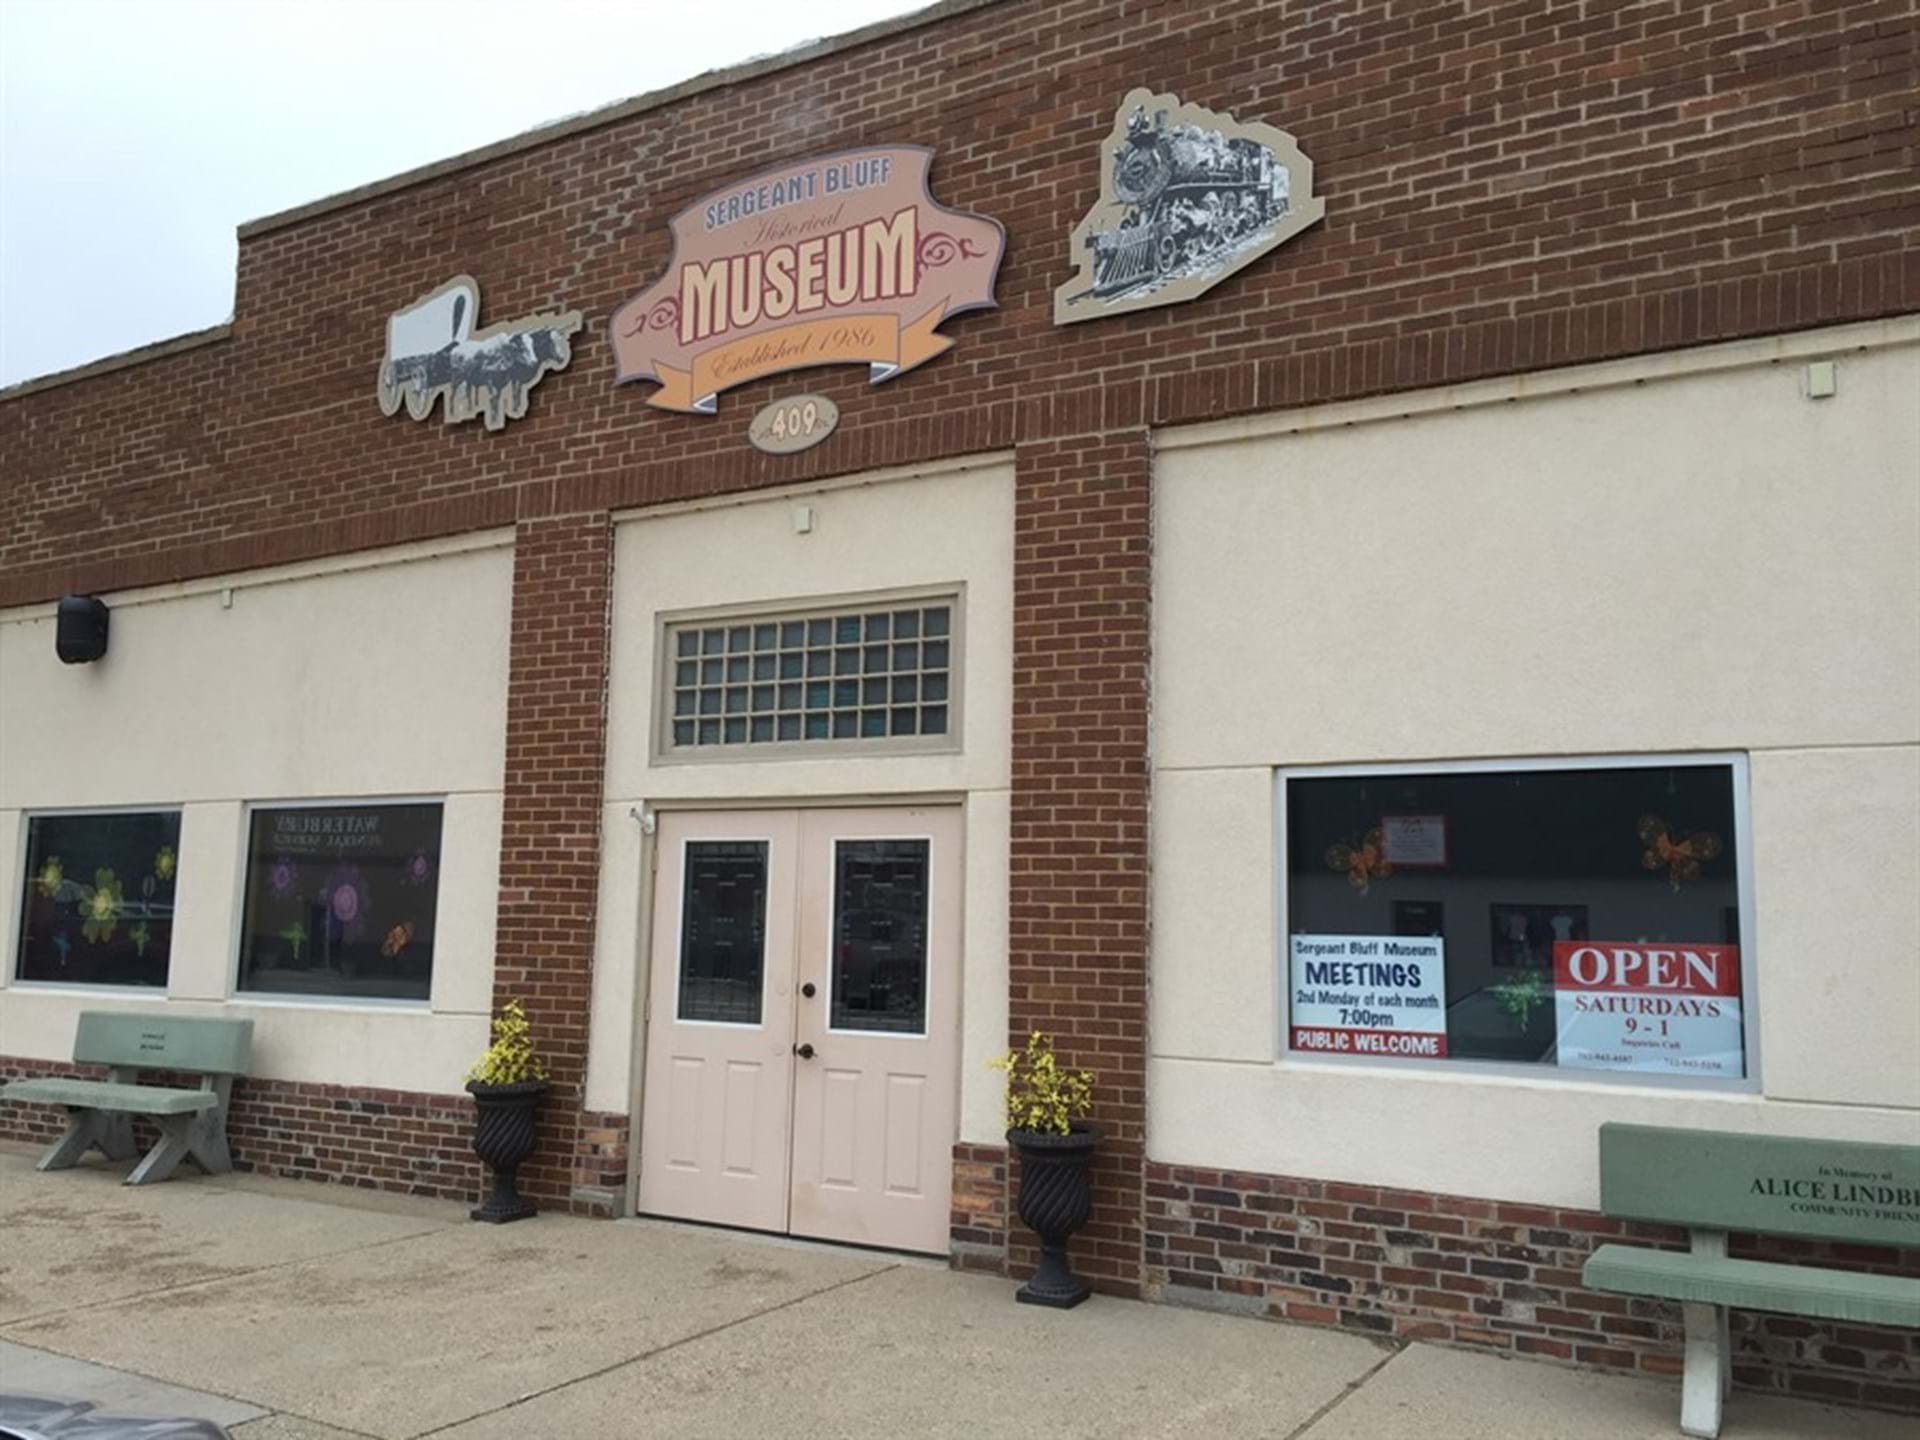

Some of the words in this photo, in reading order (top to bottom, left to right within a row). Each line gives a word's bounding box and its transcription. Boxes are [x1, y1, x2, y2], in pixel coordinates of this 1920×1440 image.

[705, 172, 817, 230] SERGEANT
[824, 157, 891, 193] BLUFF
[744, 203, 844, 247] Historical
[679, 206, 918, 347] MUSEUM
[711, 335, 812, 379] Established
[818, 326, 875, 353] 1986
[771, 401, 818, 441] 409
[1296, 941, 1346, 956] Sergeant
[1350, 942, 1378, 955] Bluff
[1384, 943, 1438, 957] Museum
[1305, 961, 1422, 988] MEETINGS
[1568, 947, 1720, 990] OPEN
[1297, 990, 1316, 1004] 2nd
[1318, 991, 1361, 1007] Monday
[1364, 994, 1376, 1006] of
[1378, 995, 1402, 1007] each
[1405, 995, 1440, 1008] month
[1575, 995, 1721, 1017] SATURDAYS
[1339, 1009, 1394, 1028] 7:00pm
[1625, 1017, 1638, 1034] 9
[1659, 1020, 1669, 1036] 1
[1297, 1031, 1350, 1050] PUBLIC
[1354, 1034, 1440, 1055] WELCOME
[1750, 1177, 1826, 1200] ALICE
[1790, 1203, 1871, 1218] COMMUNITY
